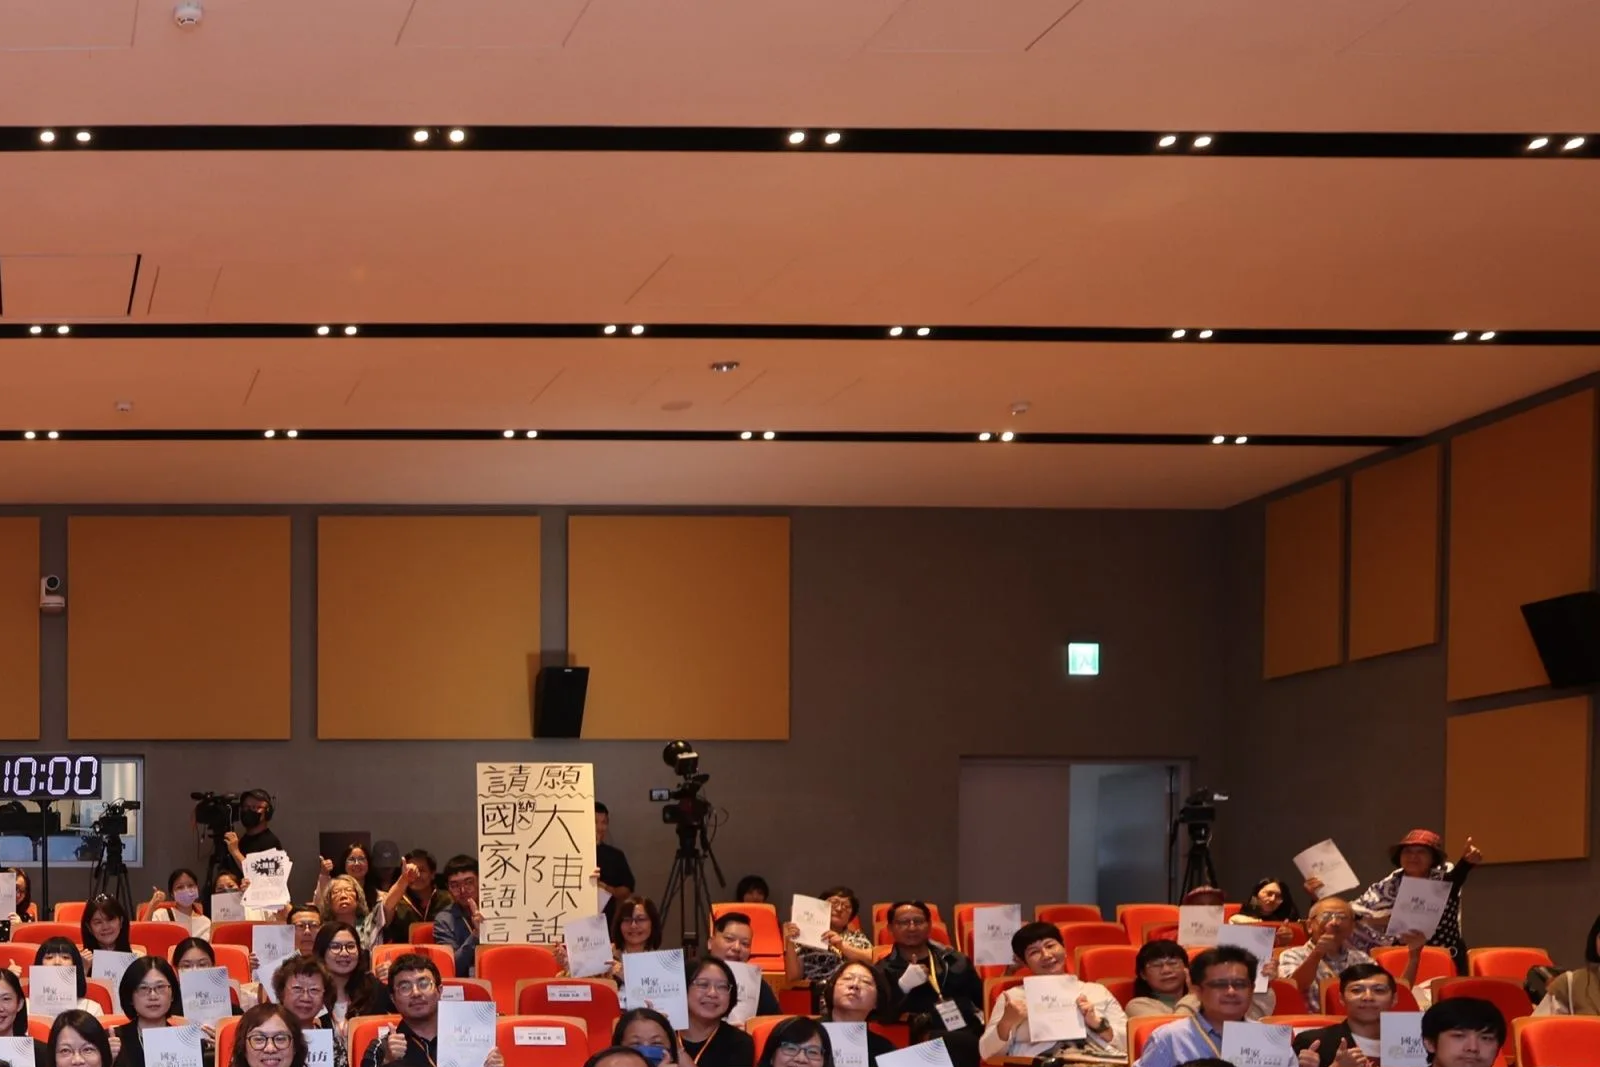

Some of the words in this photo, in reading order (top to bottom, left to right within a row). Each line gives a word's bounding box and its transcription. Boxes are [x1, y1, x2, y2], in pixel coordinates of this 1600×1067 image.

[3, 756, 98, 795] 10:00
[483, 764, 584, 794] 請願
[480, 802, 520, 942] 國家語言
